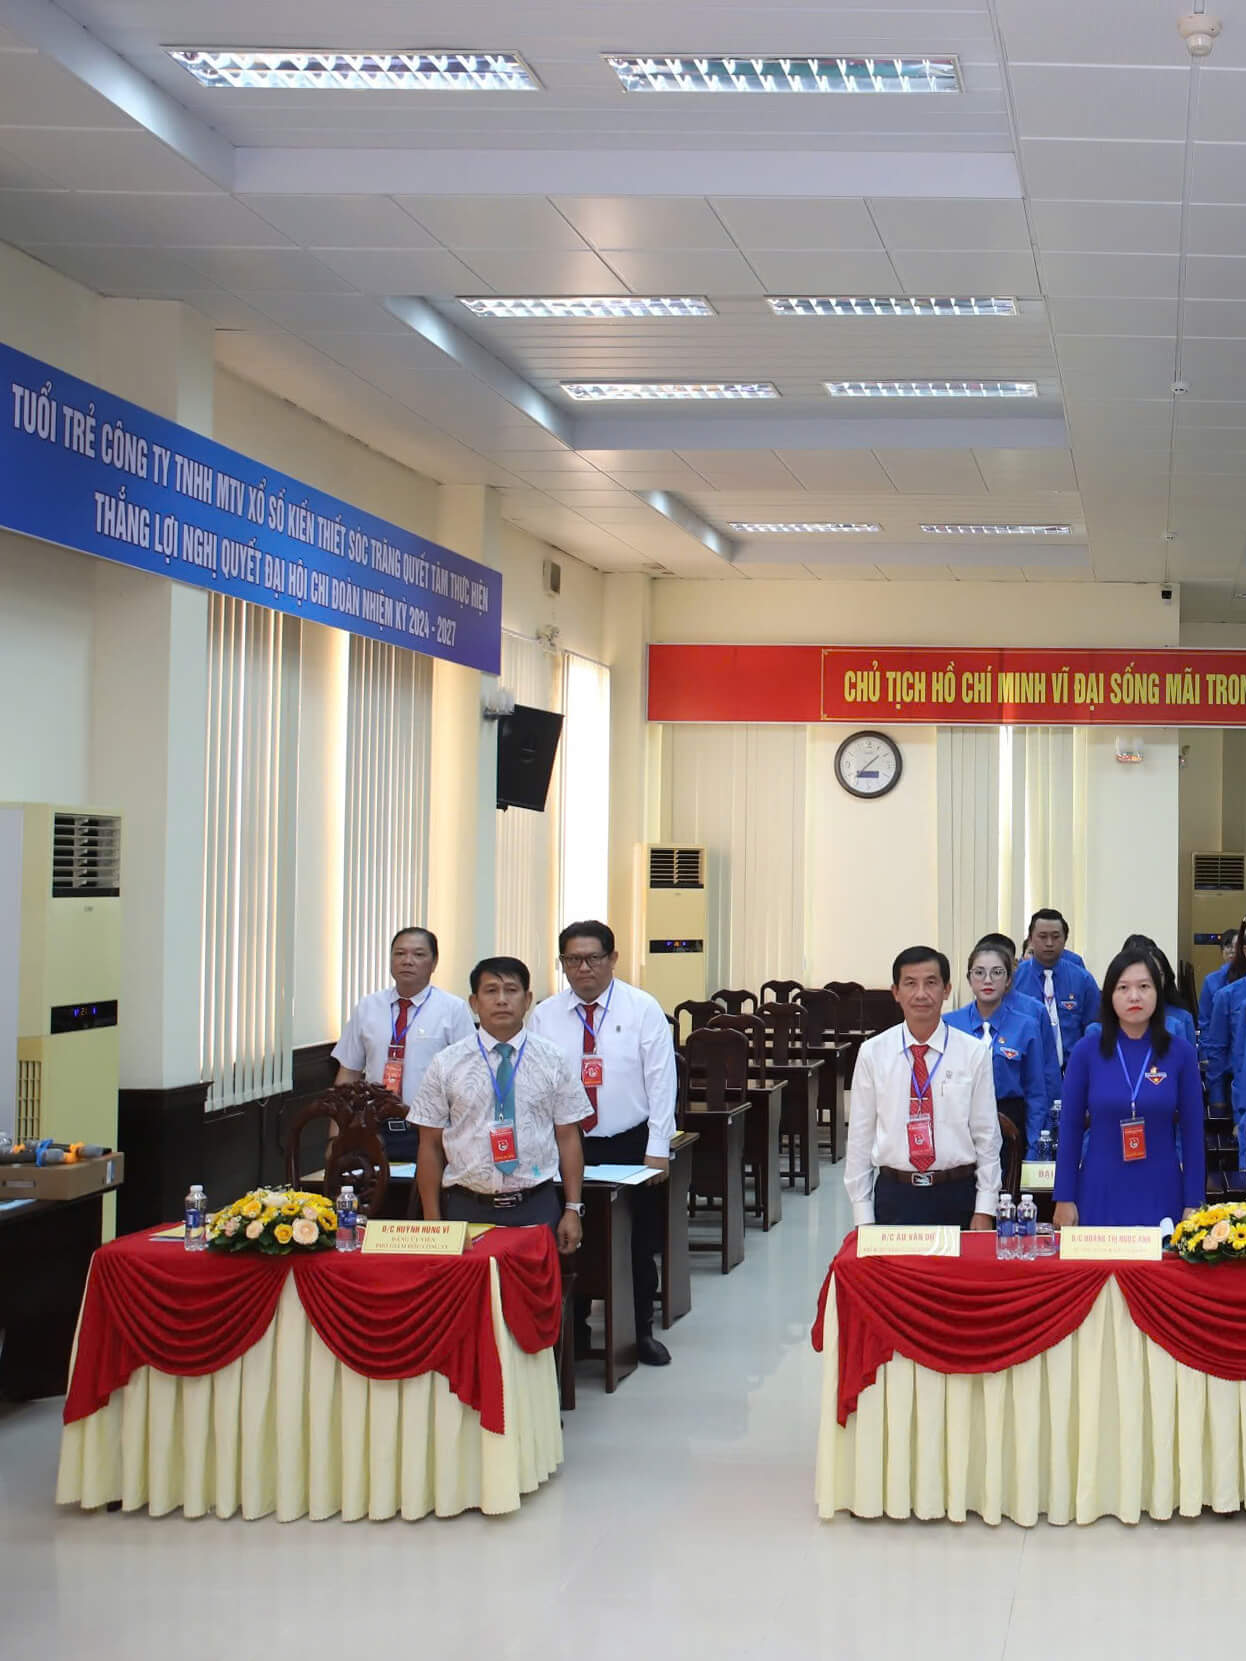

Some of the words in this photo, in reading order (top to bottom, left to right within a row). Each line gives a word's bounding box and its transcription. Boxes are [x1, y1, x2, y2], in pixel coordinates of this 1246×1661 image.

[12, 381, 56, 443] TUỔI
[63, 403, 95, 458] TRẺ
[101, 420, 147, 479] CÔNG
[152, 444, 170, 488] TY
[175, 454, 212, 504] TNHH
[216, 472, 245, 516] MTV
[248, 476, 267, 525] XỔ
[268, 488, 286, 533] SỐ
[288, 498, 315, 544] KIẾN
[318, 514, 346, 556] THIẾT
[348, 526, 368, 566] SÓC
[403, 552, 429, 588] QUYẾT
[155, 512, 178, 564] LỢI
[183, 524, 218, 579] NGHỊ
[221, 537, 262, 585] QUYẾT
[264, 553, 284, 598] ĐẠI
[288, 559, 308, 606] HỘI
[310, 570, 329, 608] CHI
[332, 576, 360, 616] ĐOÀN
[362, 588, 392, 630] NHIỆM
[409, 606, 429, 639] 2024
[436, 616, 456, 648] 2027
[844, 660, 880, 703] CHỦ
[886, 671, 926, 710] TỊCH
[932, 661, 956, 703] HỒ
[962, 666, 992, 703] CHÍ
[998, 672, 1046, 704] MINH
[1052, 667, 1070, 704] VĨ
[1074, 672, 1104, 710] ĐẠI
[1110, 662, 1160, 704] SỐNG
[1165, 668, 1200, 705] MÃI
